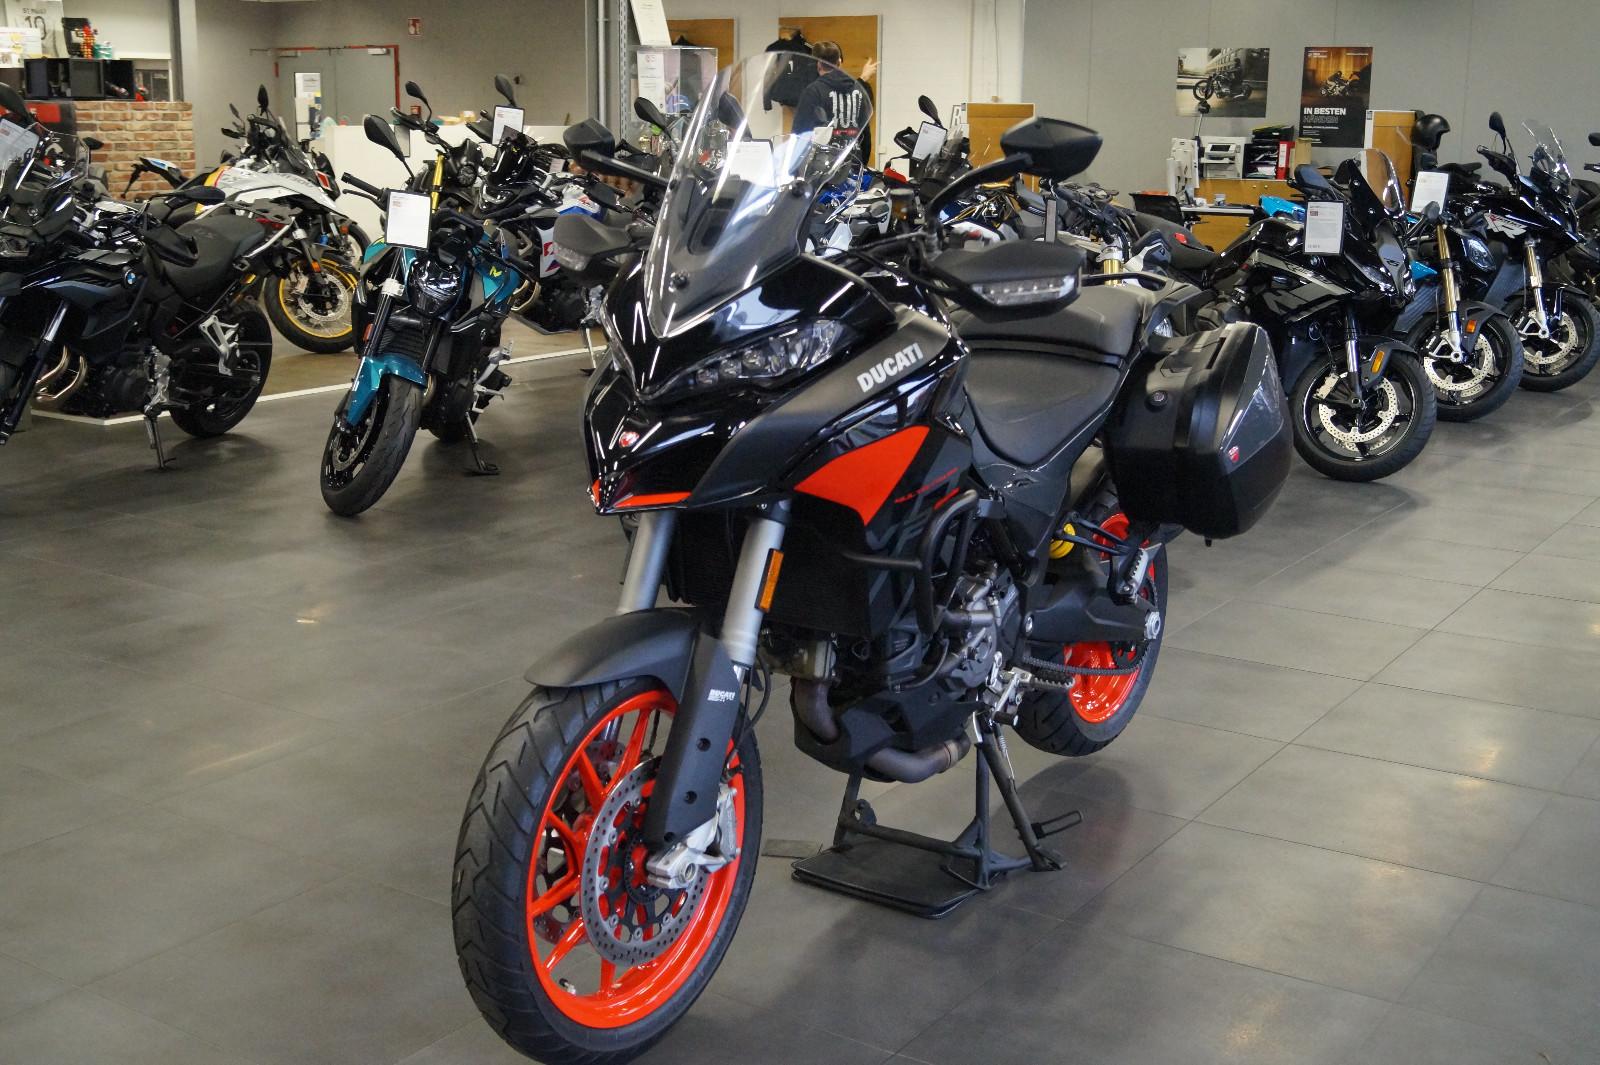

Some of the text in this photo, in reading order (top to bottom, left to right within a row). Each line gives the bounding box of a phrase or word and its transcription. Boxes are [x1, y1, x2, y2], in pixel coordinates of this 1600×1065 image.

[1303, 107, 1347, 116] IN BESTEN
[857, 342, 924, 393] DUCATI
[708, 689, 735, 701] DUCATI
